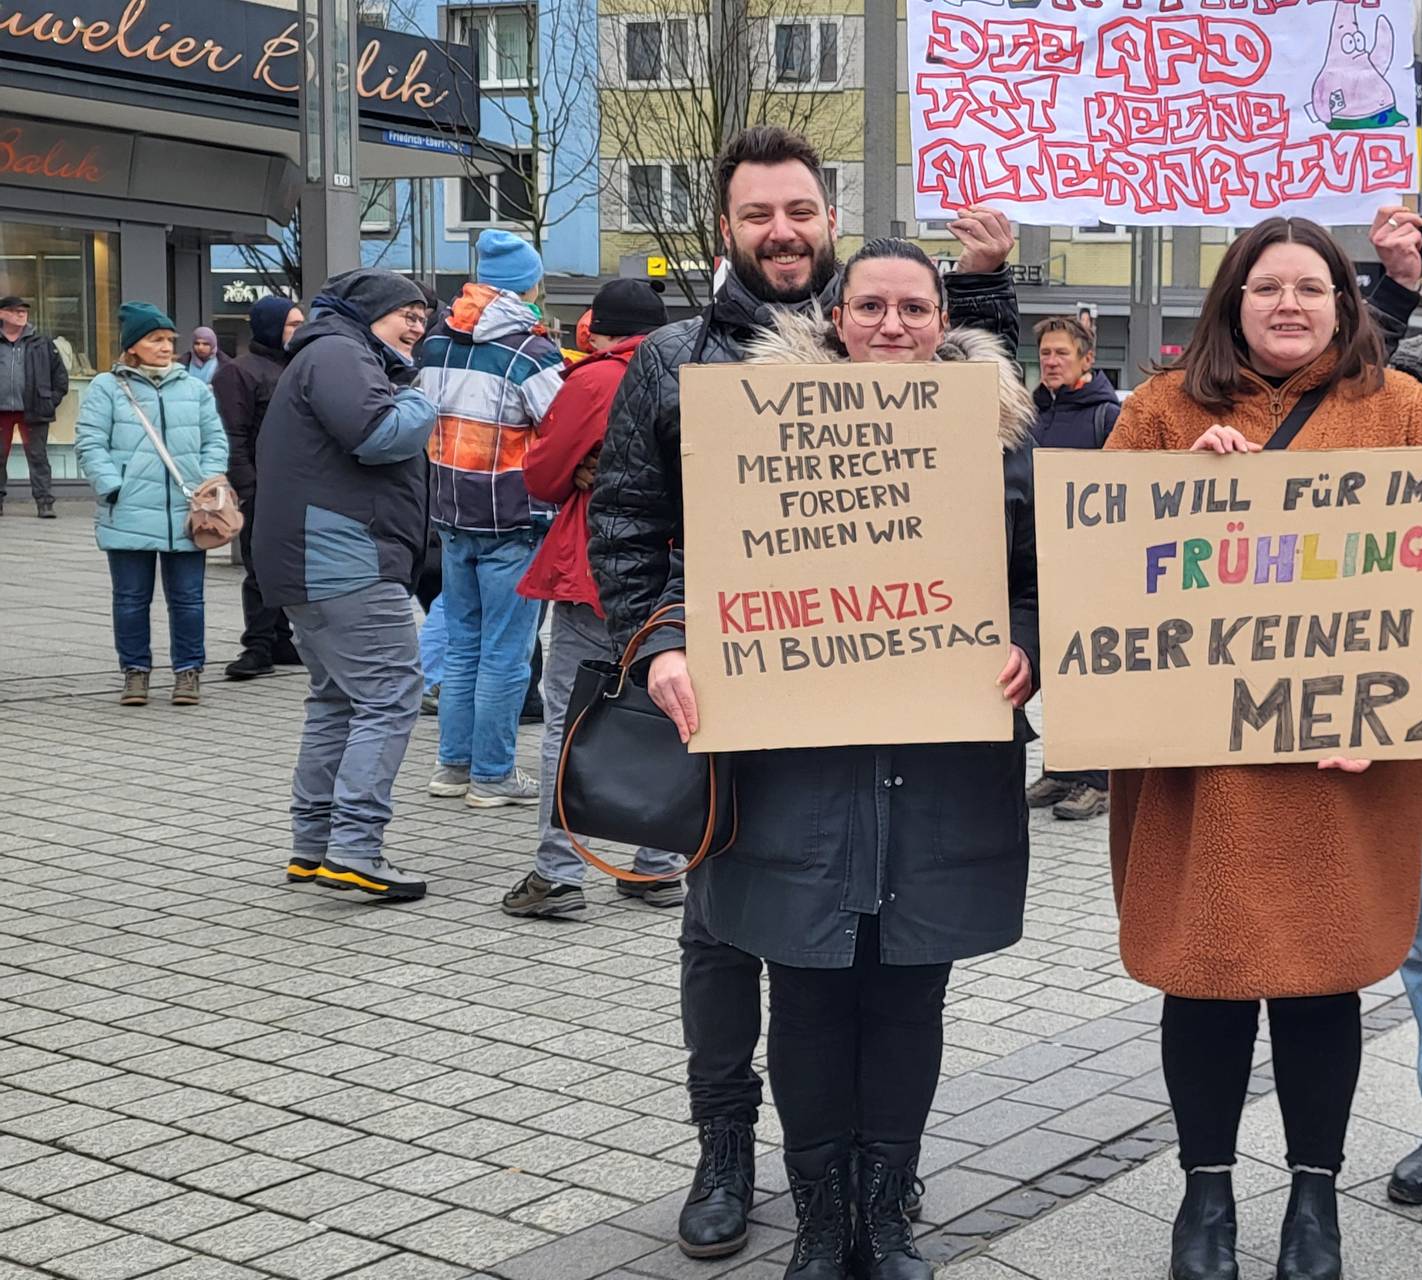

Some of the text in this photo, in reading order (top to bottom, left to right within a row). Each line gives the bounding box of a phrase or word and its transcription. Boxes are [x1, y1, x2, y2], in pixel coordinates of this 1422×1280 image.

[925, 10, 1084, 75] DIE
[916, 72, 1291, 145] IST KEINE
[915, 132, 1416, 215] ALTERNATIVE
[741, 379, 940, 416] WENN WIR
[779, 421, 894, 452] FRAUEN
[737, 446, 938, 485] MEHR RECHTE
[780, 481, 910, 518] FORDERN
[1065, 481, 1127, 529] ICH
[1151, 478, 1251, 520] WILL
[741, 515, 924, 558] MEINEN WIR
[717, 579, 954, 634] KEINE NAZIS
[722, 619, 1001, 677] IM BUNDESTAG
[1057, 607, 1415, 676] ABER KEINEN
